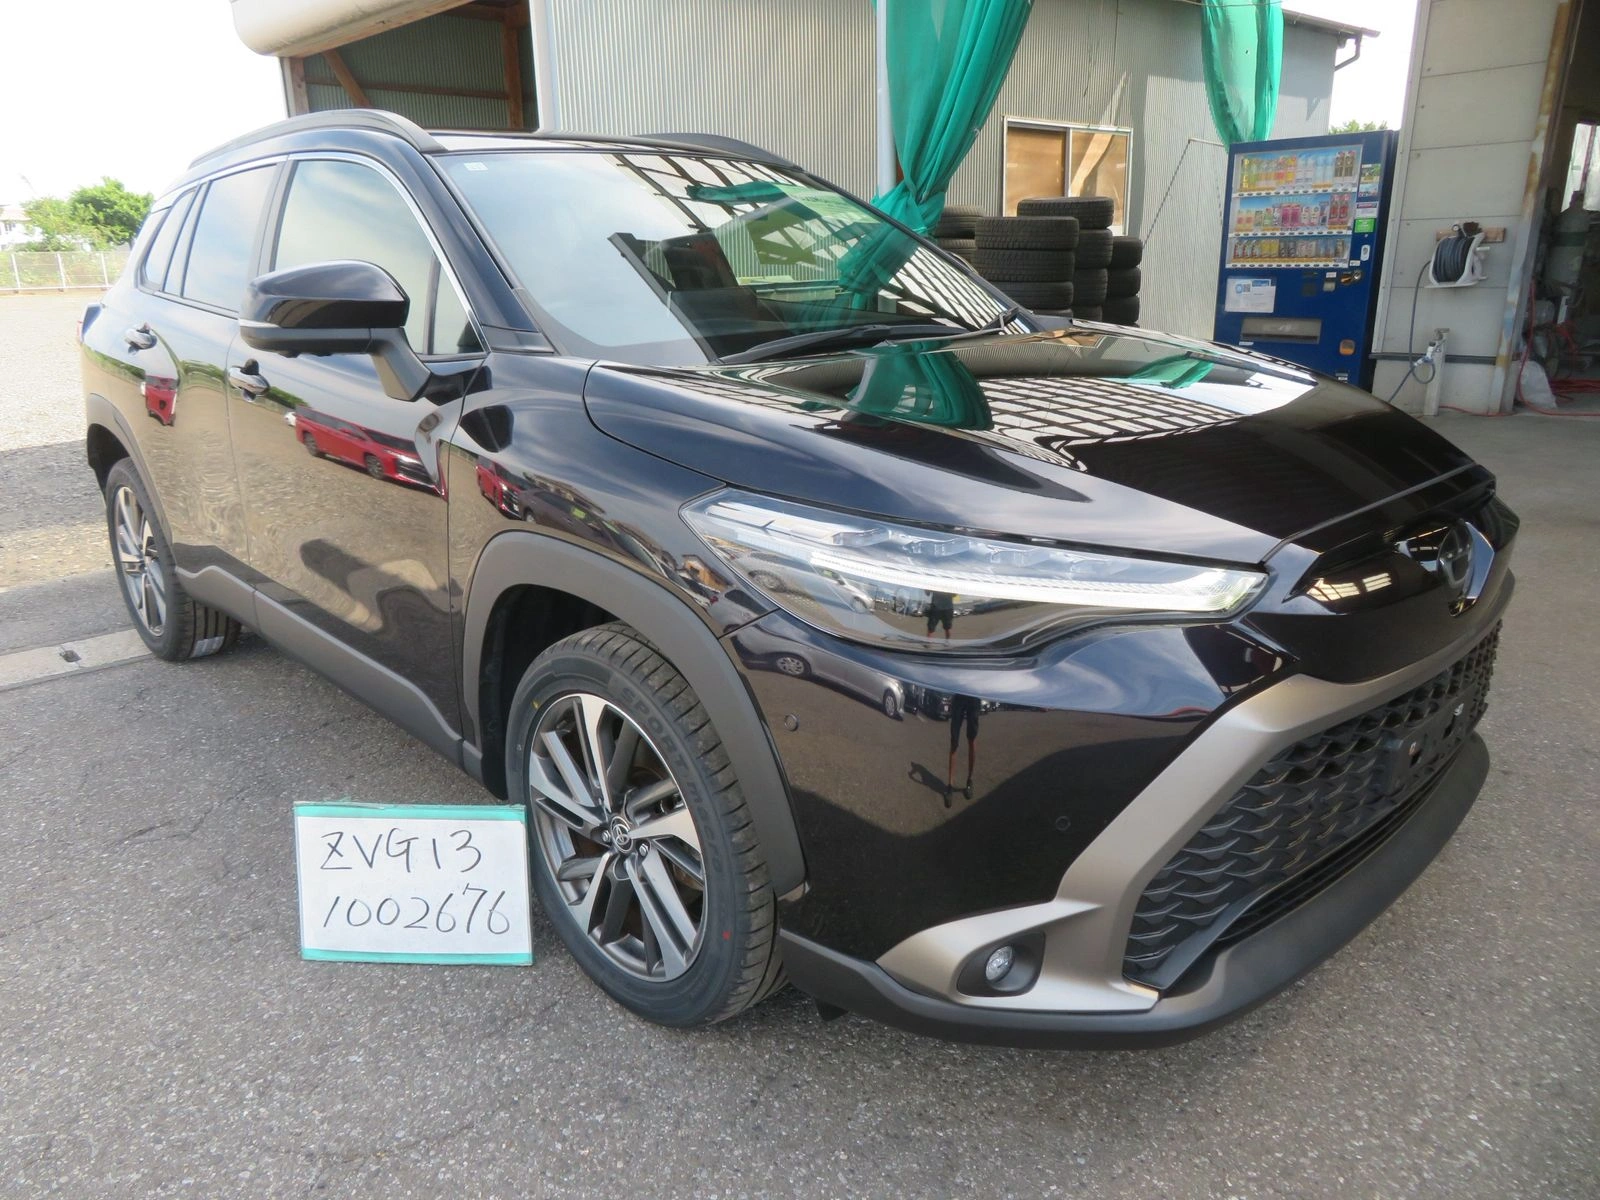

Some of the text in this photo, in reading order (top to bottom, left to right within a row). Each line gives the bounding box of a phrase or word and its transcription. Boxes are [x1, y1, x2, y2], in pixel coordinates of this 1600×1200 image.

[622, 686, 688, 773] SPORT
[320, 827, 481, 873] ZVG13
[323, 883, 510, 934] 1002676
